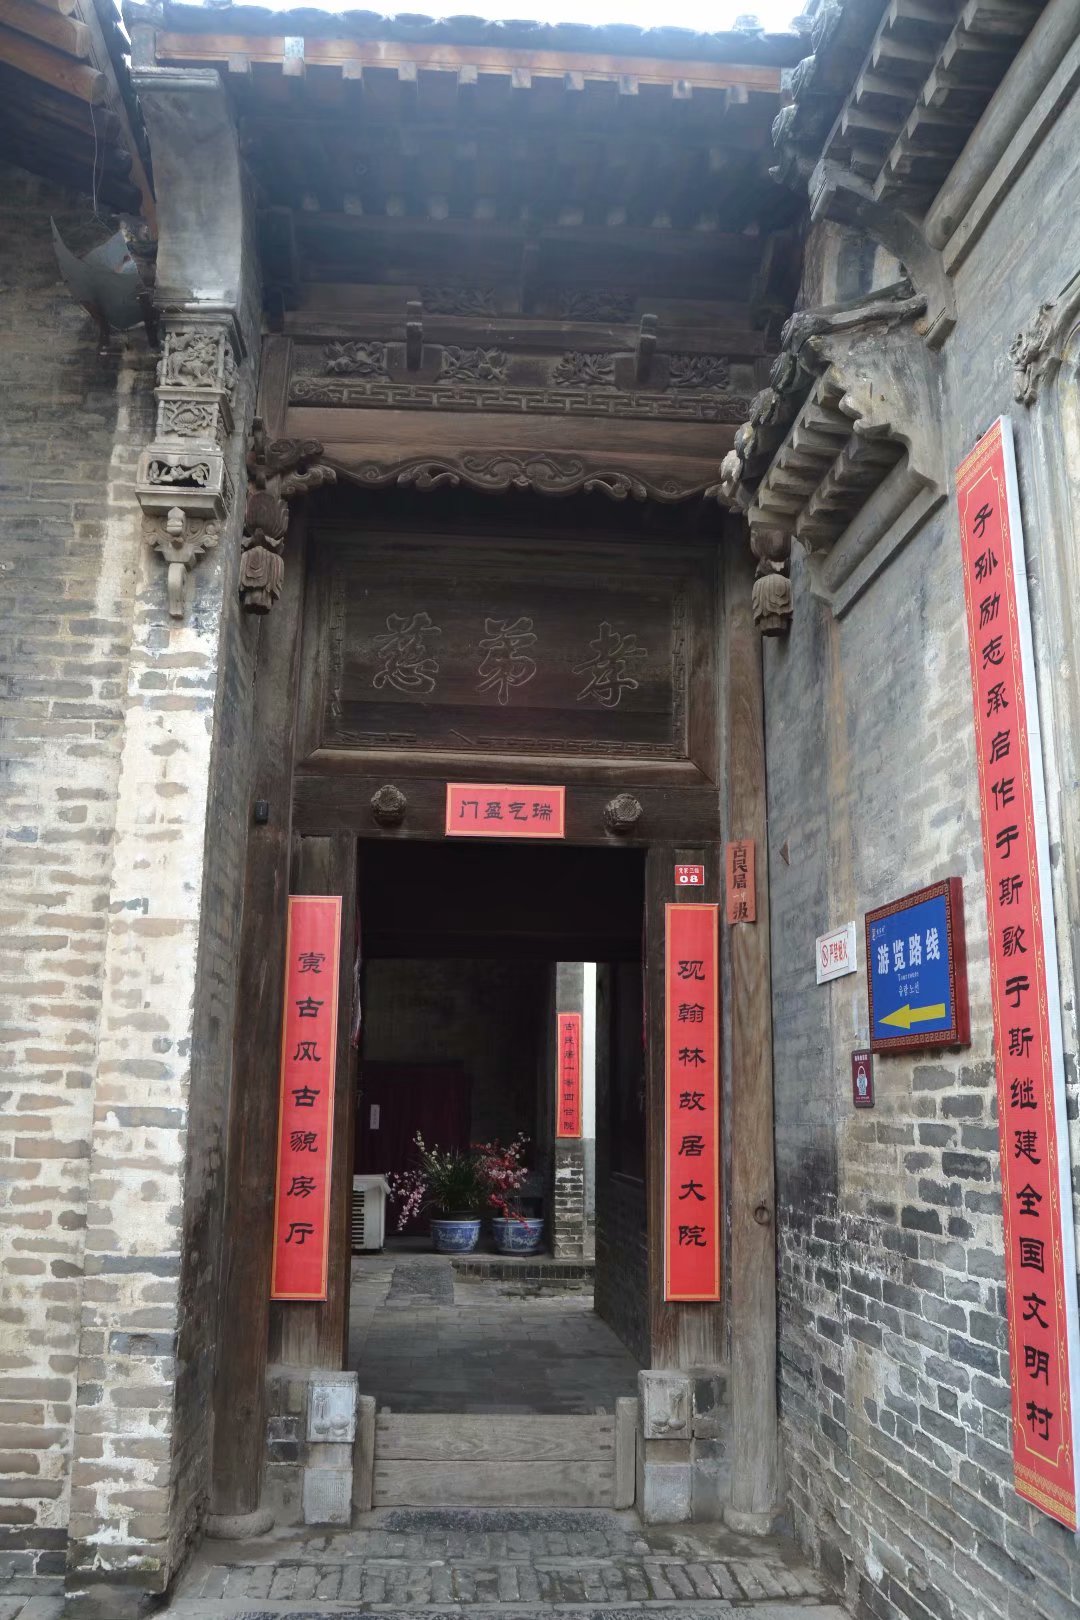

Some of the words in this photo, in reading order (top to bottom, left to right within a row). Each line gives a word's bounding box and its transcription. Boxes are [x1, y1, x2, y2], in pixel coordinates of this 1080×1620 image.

[679, 874, 699, 883] 08
[877, 927, 940, 974] 游览路线
[284, 951, 326, 1244] 赏古风古貌房厅
[677, 960, 707, 1248] 观翰林故居大院
